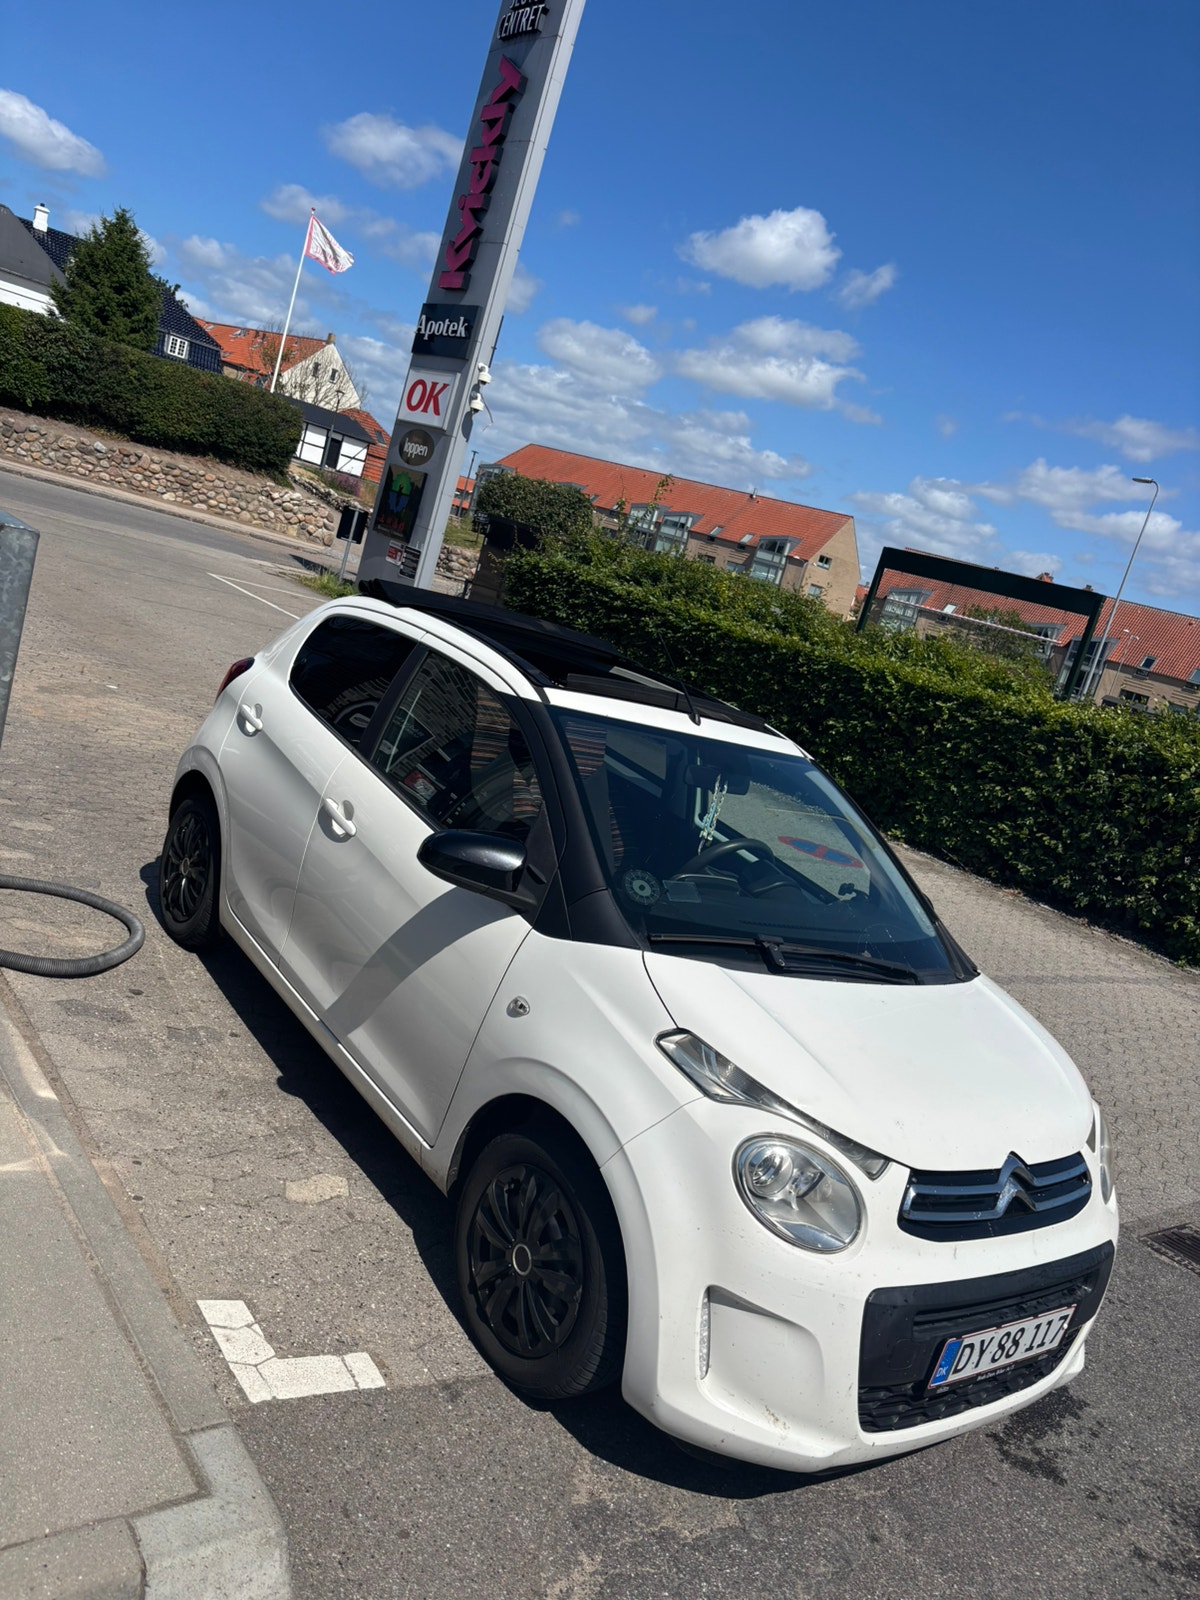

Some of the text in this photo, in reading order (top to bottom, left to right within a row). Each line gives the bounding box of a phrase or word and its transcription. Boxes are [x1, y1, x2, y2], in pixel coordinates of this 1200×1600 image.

[497, 4, 546, 38] CENTRET
[438, 54, 525, 290] Kvickly
[414, 314, 469, 340] Apotek
[406, 379, 450, 417] OK
[952, 1314, 1070, 1375] DY 88 117
[936, 1366, 949, 1377] DK
